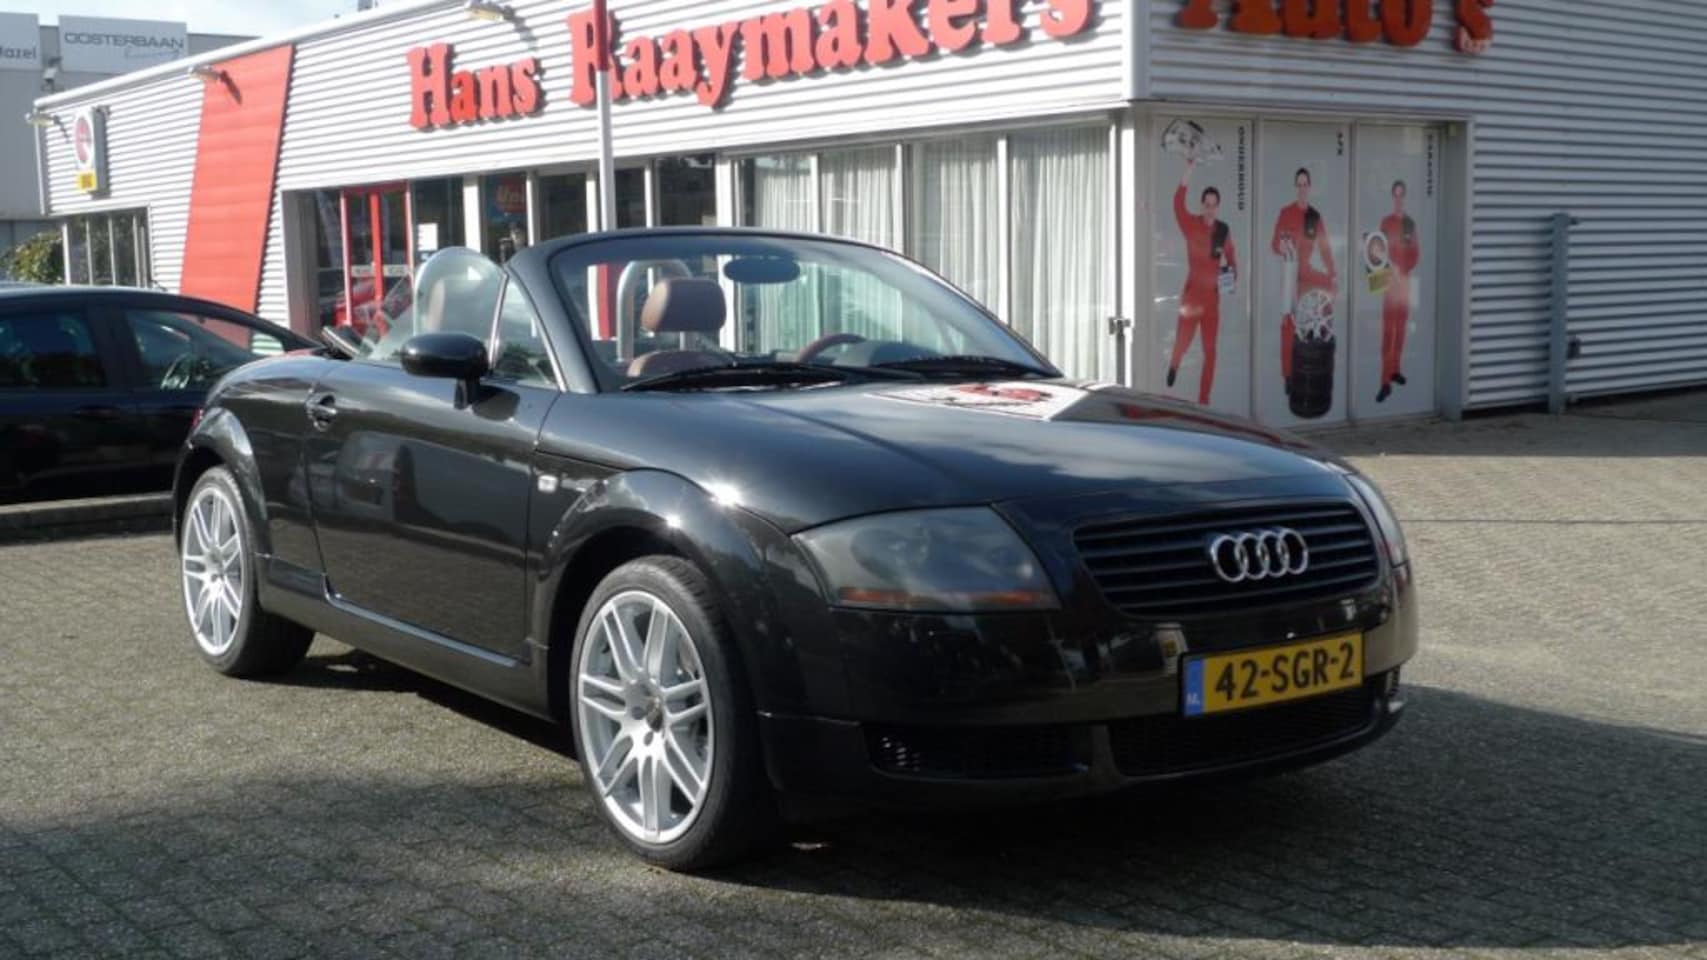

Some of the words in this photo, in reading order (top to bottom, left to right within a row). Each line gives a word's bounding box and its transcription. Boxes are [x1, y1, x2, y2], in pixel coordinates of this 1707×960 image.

[64, 32, 185, 49] OOSTERBAAN
[405, 43, 542, 131] Hans
[1213, 642, 1355, 702] 42-SGR-2
